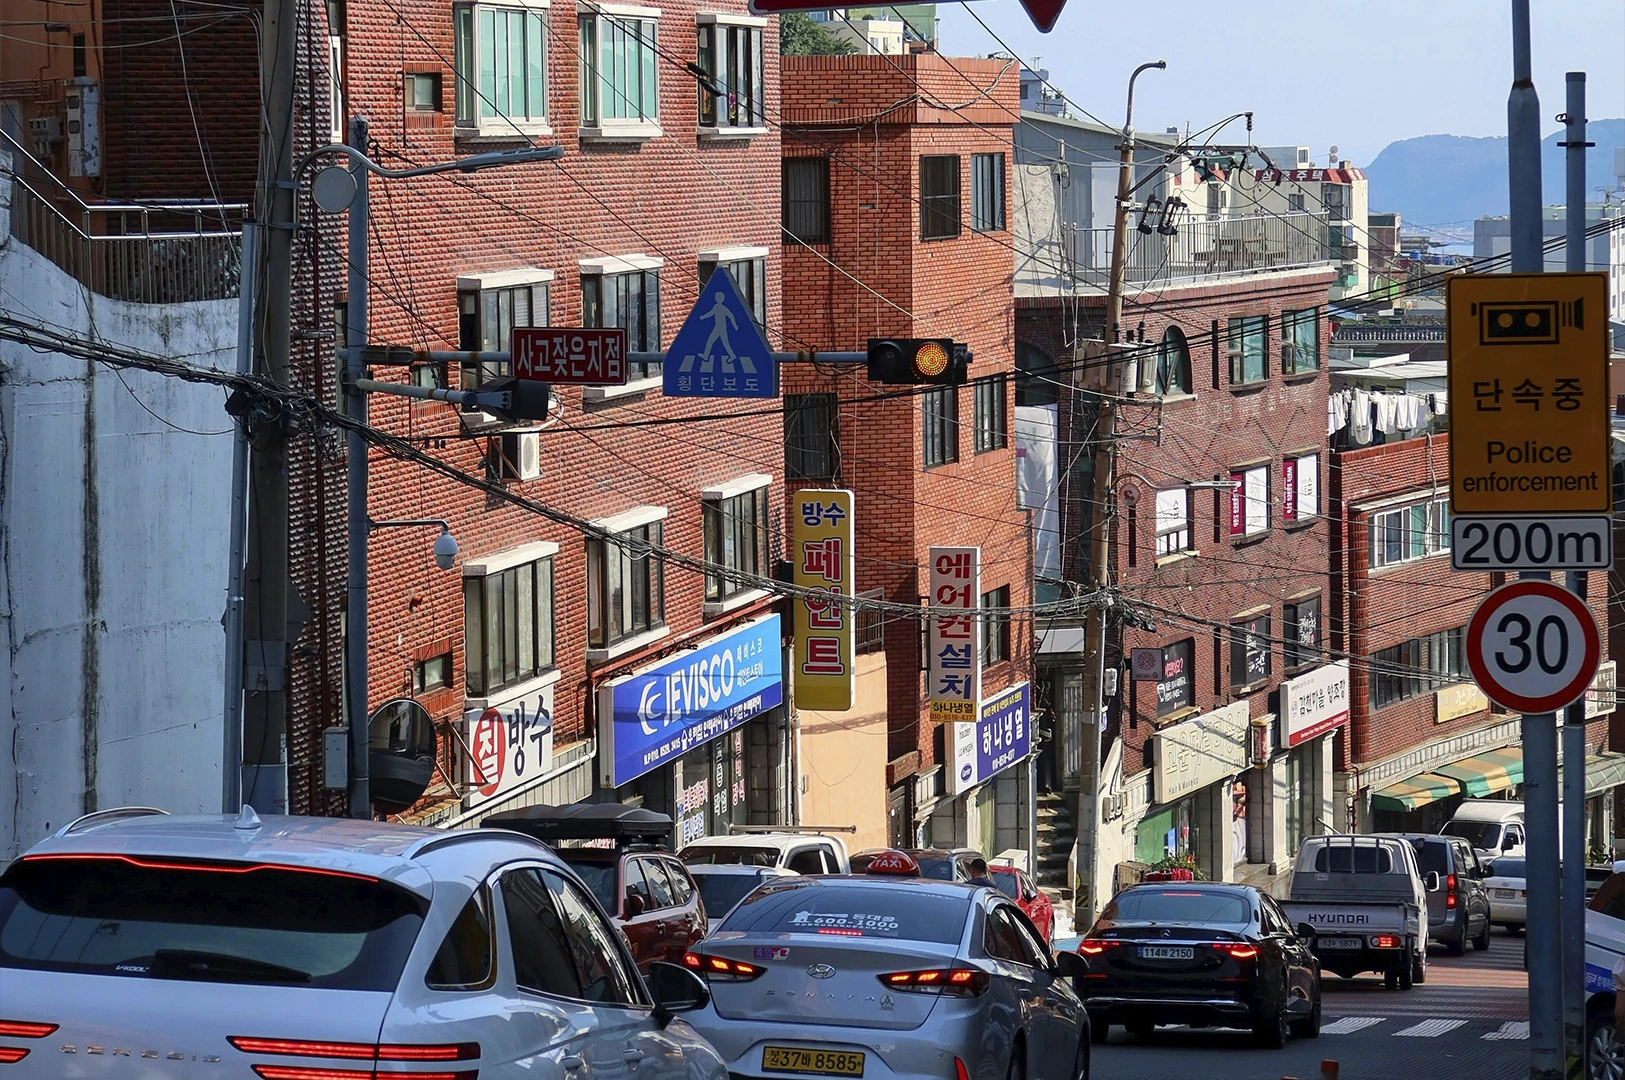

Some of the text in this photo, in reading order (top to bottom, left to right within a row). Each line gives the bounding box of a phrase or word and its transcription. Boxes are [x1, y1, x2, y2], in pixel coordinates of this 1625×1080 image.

[517, 334, 620, 378] 사고잦은지점
[677, 376, 760, 392] 횡단보도
[1473, 378, 1584, 411] 단속중
[1487, 441, 1572, 464] Police
[1463, 471, 1598, 493] enforcement
[802, 502, 846, 527] 방수
[1462, 522, 1602, 564] 200m
[802, 538, 845, 676] 페인트
[1495, 613, 1569, 674] 30
[664, 649, 735, 727] JEVISCO
[933, 702, 973, 713] 하나냉열
[1300, 688, 1325, 716] 감천마을
[478, 695, 551, 785] 칠 방수
[983, 706, 1023, 756] 하나냉열
[875, 859, 902, 868] TAXI
[814, 918, 899, 929] 600-1000
[1308, 913, 1369, 924] HYUNDAI
[1169, 948, 1192, 958] 2150
[766, 990, 875, 1002] SONATA
[59, 1044, 221, 1063] GENESIS
[780, 1050, 812, 1068] 37바
[815, 1052, 858, 1071] 8585
